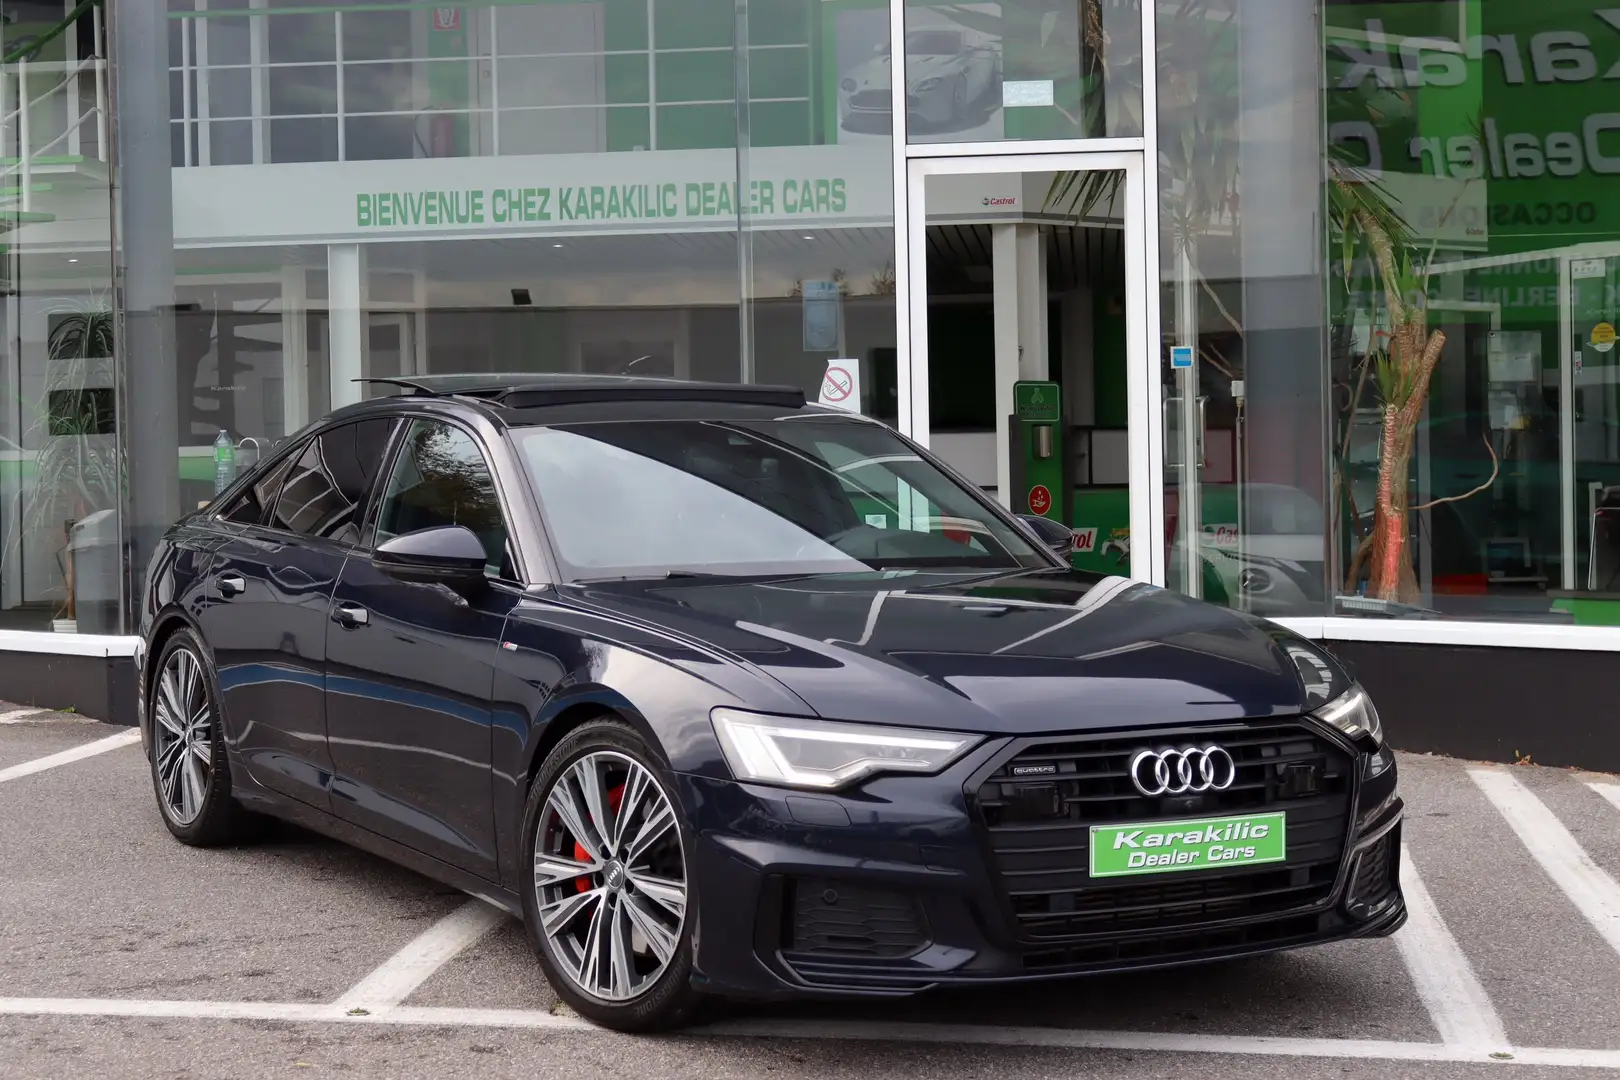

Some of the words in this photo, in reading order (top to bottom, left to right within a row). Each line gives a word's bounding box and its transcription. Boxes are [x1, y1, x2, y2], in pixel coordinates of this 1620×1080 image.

[356, 190, 484, 227] BIENVENUE
[492, 187, 551, 223] CHEZ
[558, 182, 678, 220] KARAKILIC
[685, 180, 775, 216] DEALER
[782, 178, 847, 214] CARS
[989, 197, 1016, 206] Castrol
[1112, 822, 1269, 850] Karakilic
[1127, 849, 1200, 868] Dealer
[1207, 844, 1256, 862] Cars
